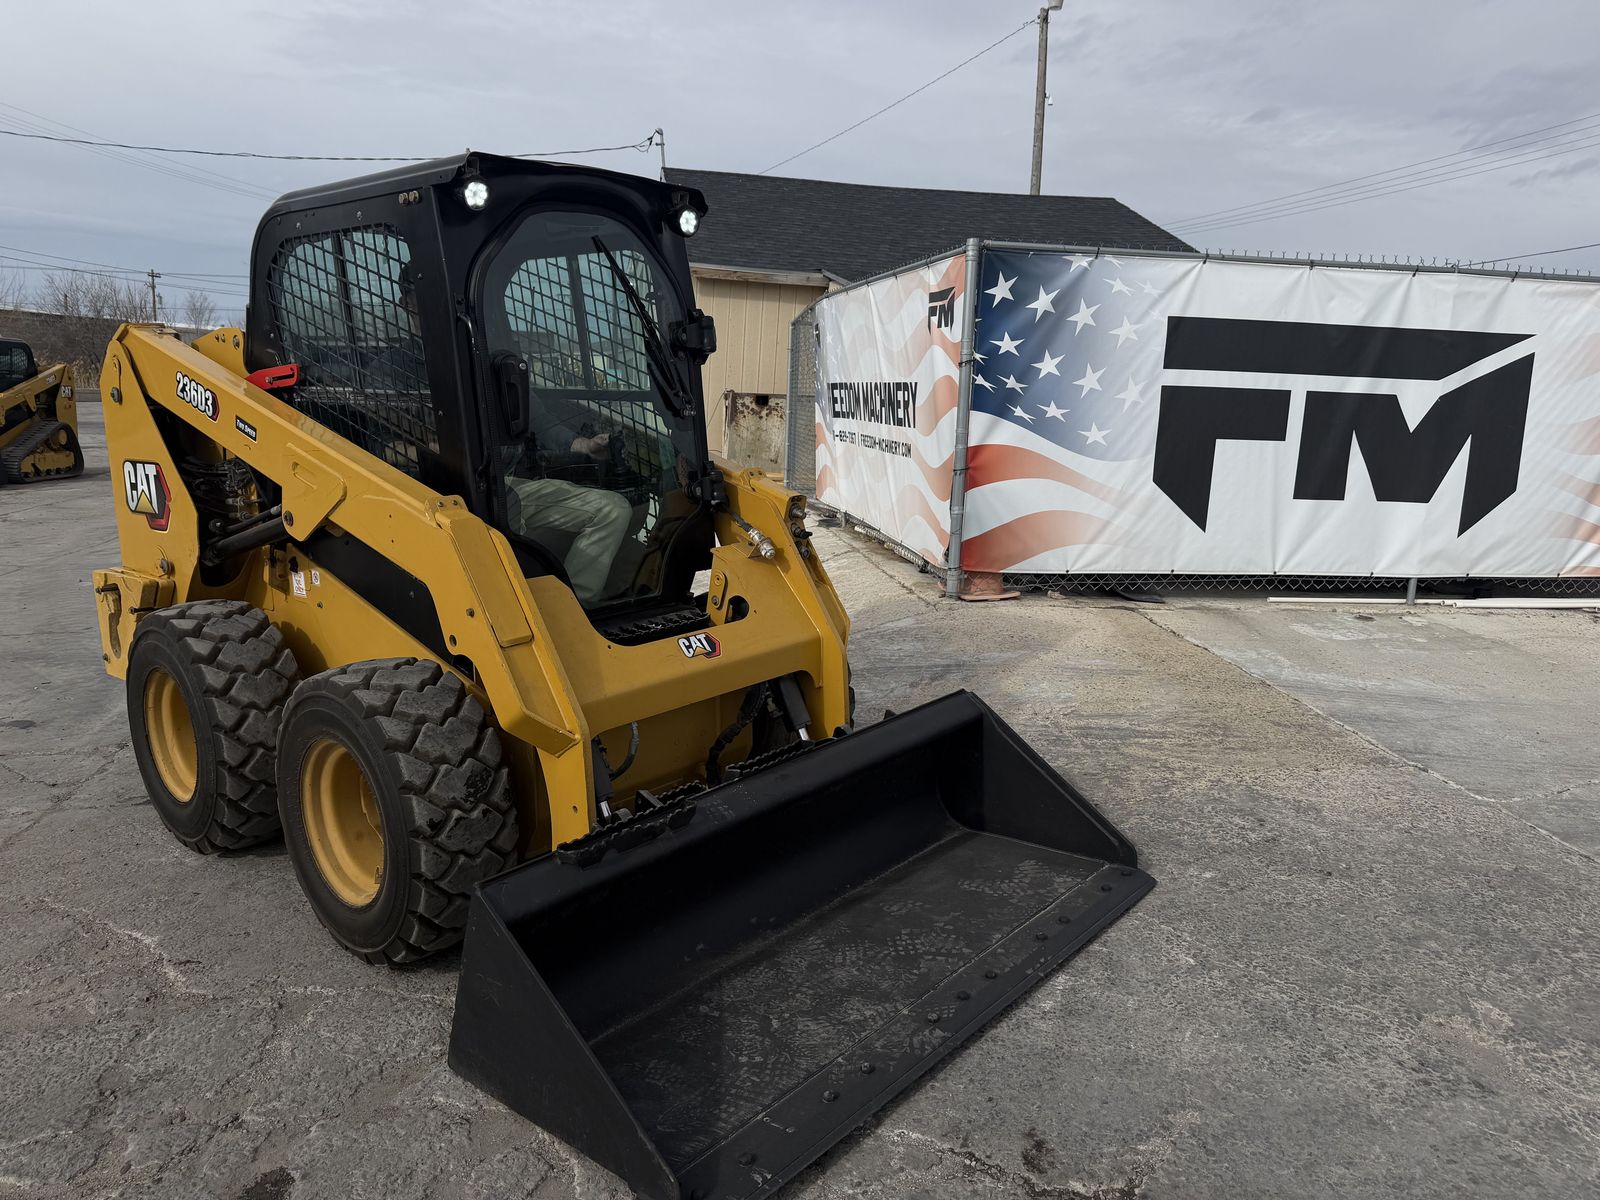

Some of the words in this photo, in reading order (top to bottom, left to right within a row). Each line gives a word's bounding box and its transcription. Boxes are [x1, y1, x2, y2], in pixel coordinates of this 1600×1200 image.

[928, 287, 956, 336] FM
[175, 371, 214, 417] 236D3
[828, 382, 862, 421] EEDOM
[1152, 315, 1537, 539] FM
[123, 461, 159, 514] CAT
[678, 633, 712, 658] CAT
